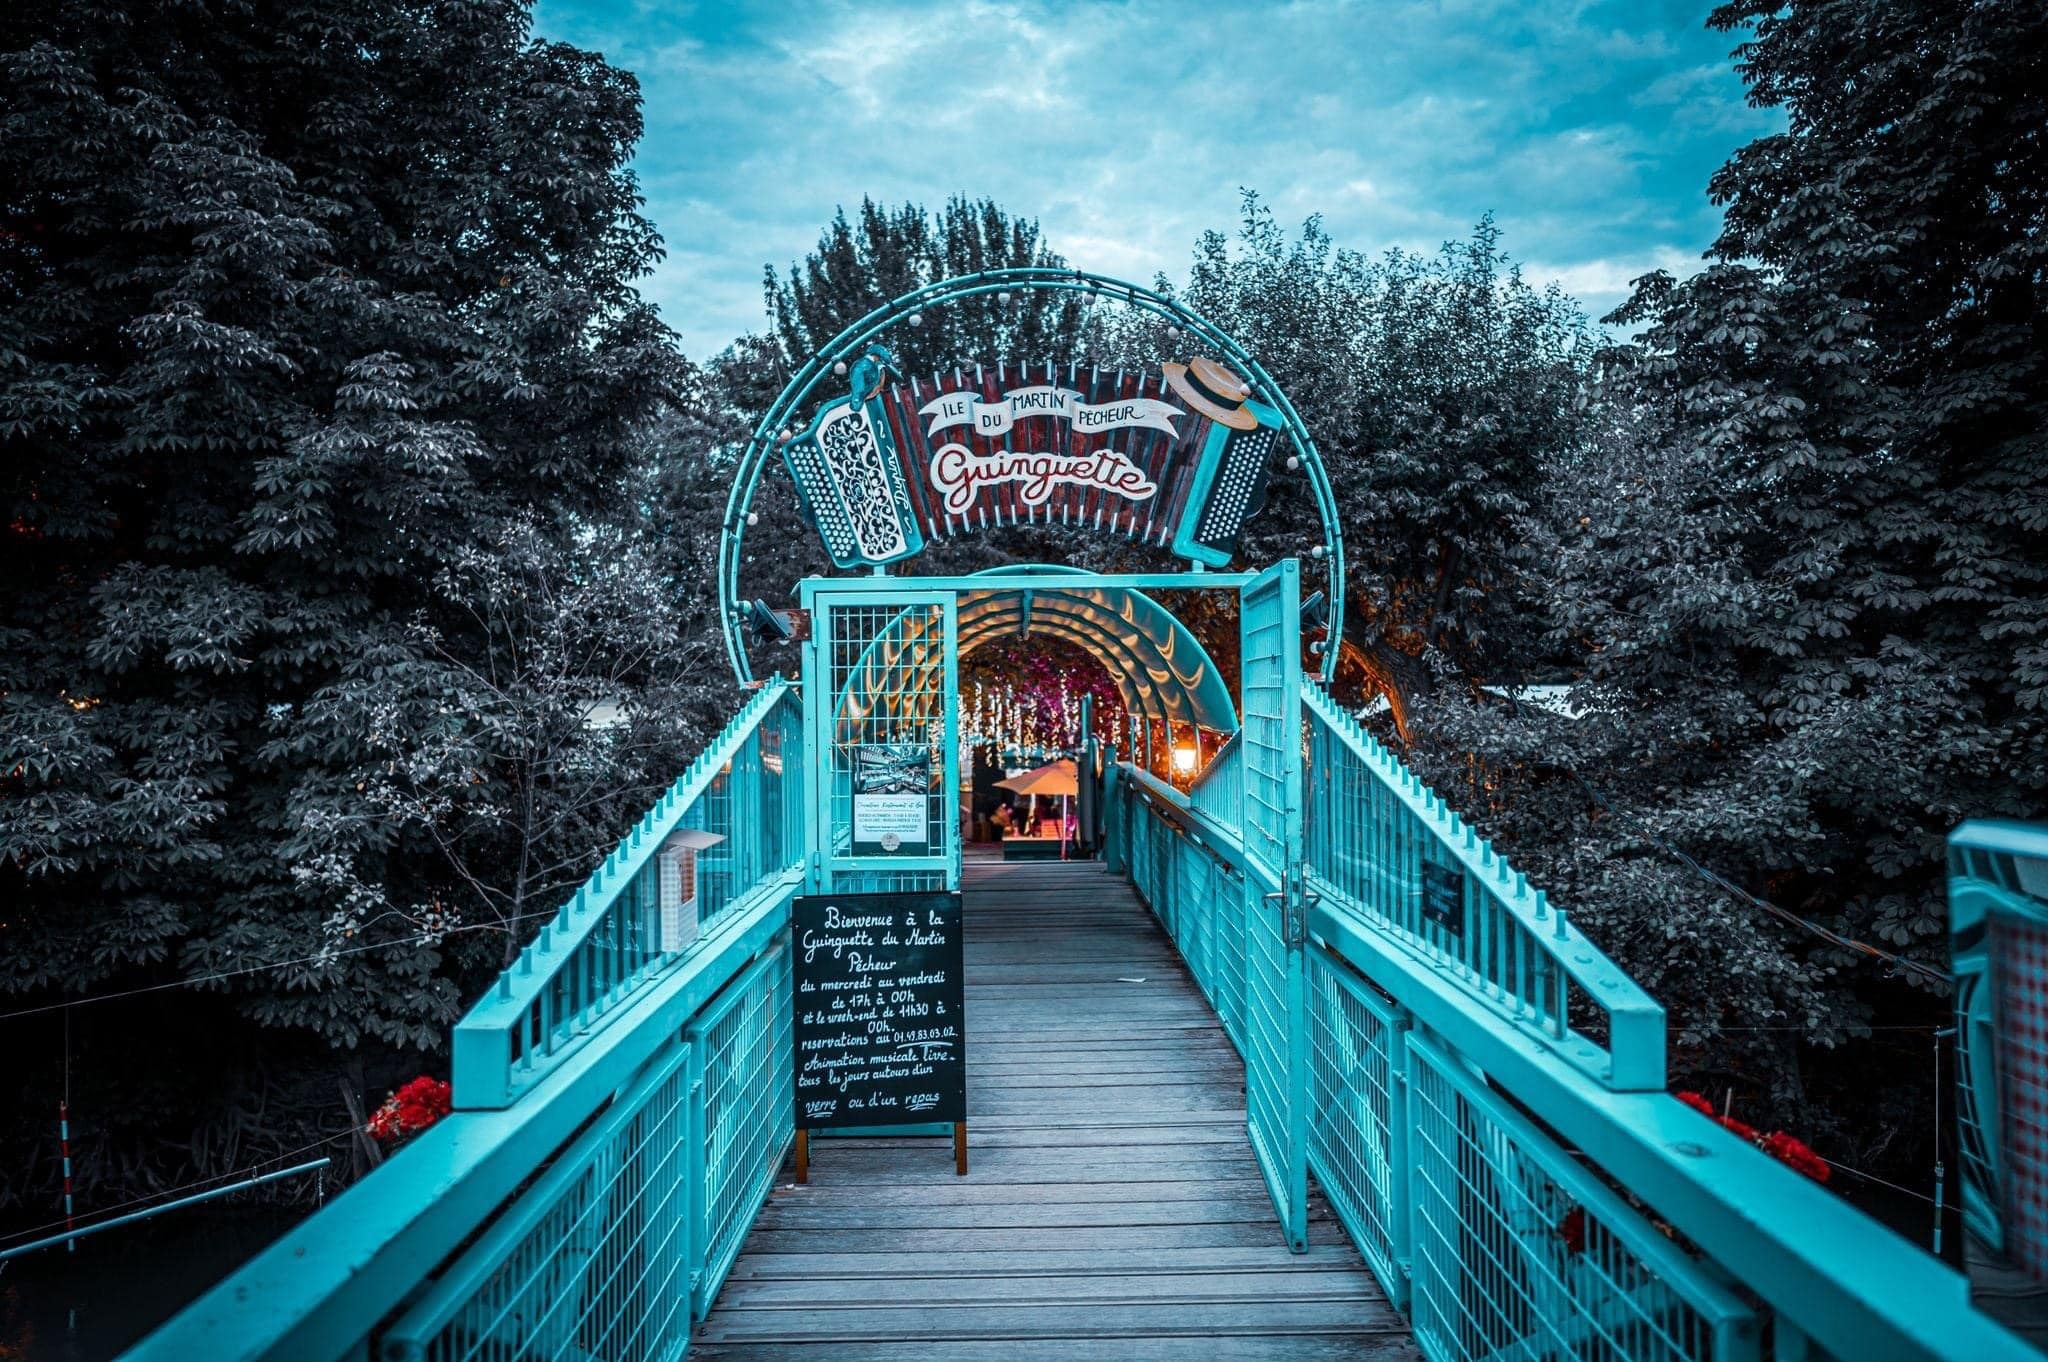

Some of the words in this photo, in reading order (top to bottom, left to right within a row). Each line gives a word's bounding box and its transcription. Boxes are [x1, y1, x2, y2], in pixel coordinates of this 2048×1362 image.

[982, 414, 1001, 427] DU
[1013, 391, 1066, 411] MARTIN
[1079, 406, 1145, 426] PÊCHEUR
[937, 449, 1151, 509] Guinguette
[825, 906, 893, 929] Bienvenue
[905, 911, 917, 926] à
[928, 909, 945, 925] la
[802, 929, 875, 963] Guinguette
[882, 932, 899, 945] du
[905, 928, 946, 946] Martin
[801, 979, 816, 992] du
[821, 975, 872, 991] mercredi
[878, 980, 894, 988] au
[900, 971, 946, 985] vendredi
[831, 996, 846, 1009] de
[850, 993, 871, 1007] 17h
[876, 992, 885, 1005] à
[891, 990, 915, 1003] 00h
[803, 1011, 814, 1025] et
[816, 1010, 826, 1025] le
[827, 1007, 878, 1024] week-end
[882, 1007, 895, 1018] de
[899, 1003, 929, 1018] 11h30
[936, 1001, 946, 1014] à
[801, 1031, 869, 1051] reservations
[875, 1034, 890, 1044] au
[804, 1052, 865, 1071] Animation
[869, 1048, 919, 1065] musicale
[798, 1073, 821, 1087] tous
[839, 1071, 870, 1093] jours
[872, 1065, 909, 1079] autours
[805, 1099, 838, 1114] verre
[848, 1098, 864, 1109] ou
[868, 1091, 898, 1107] d'un
[904, 1092, 940, 1108] repas
